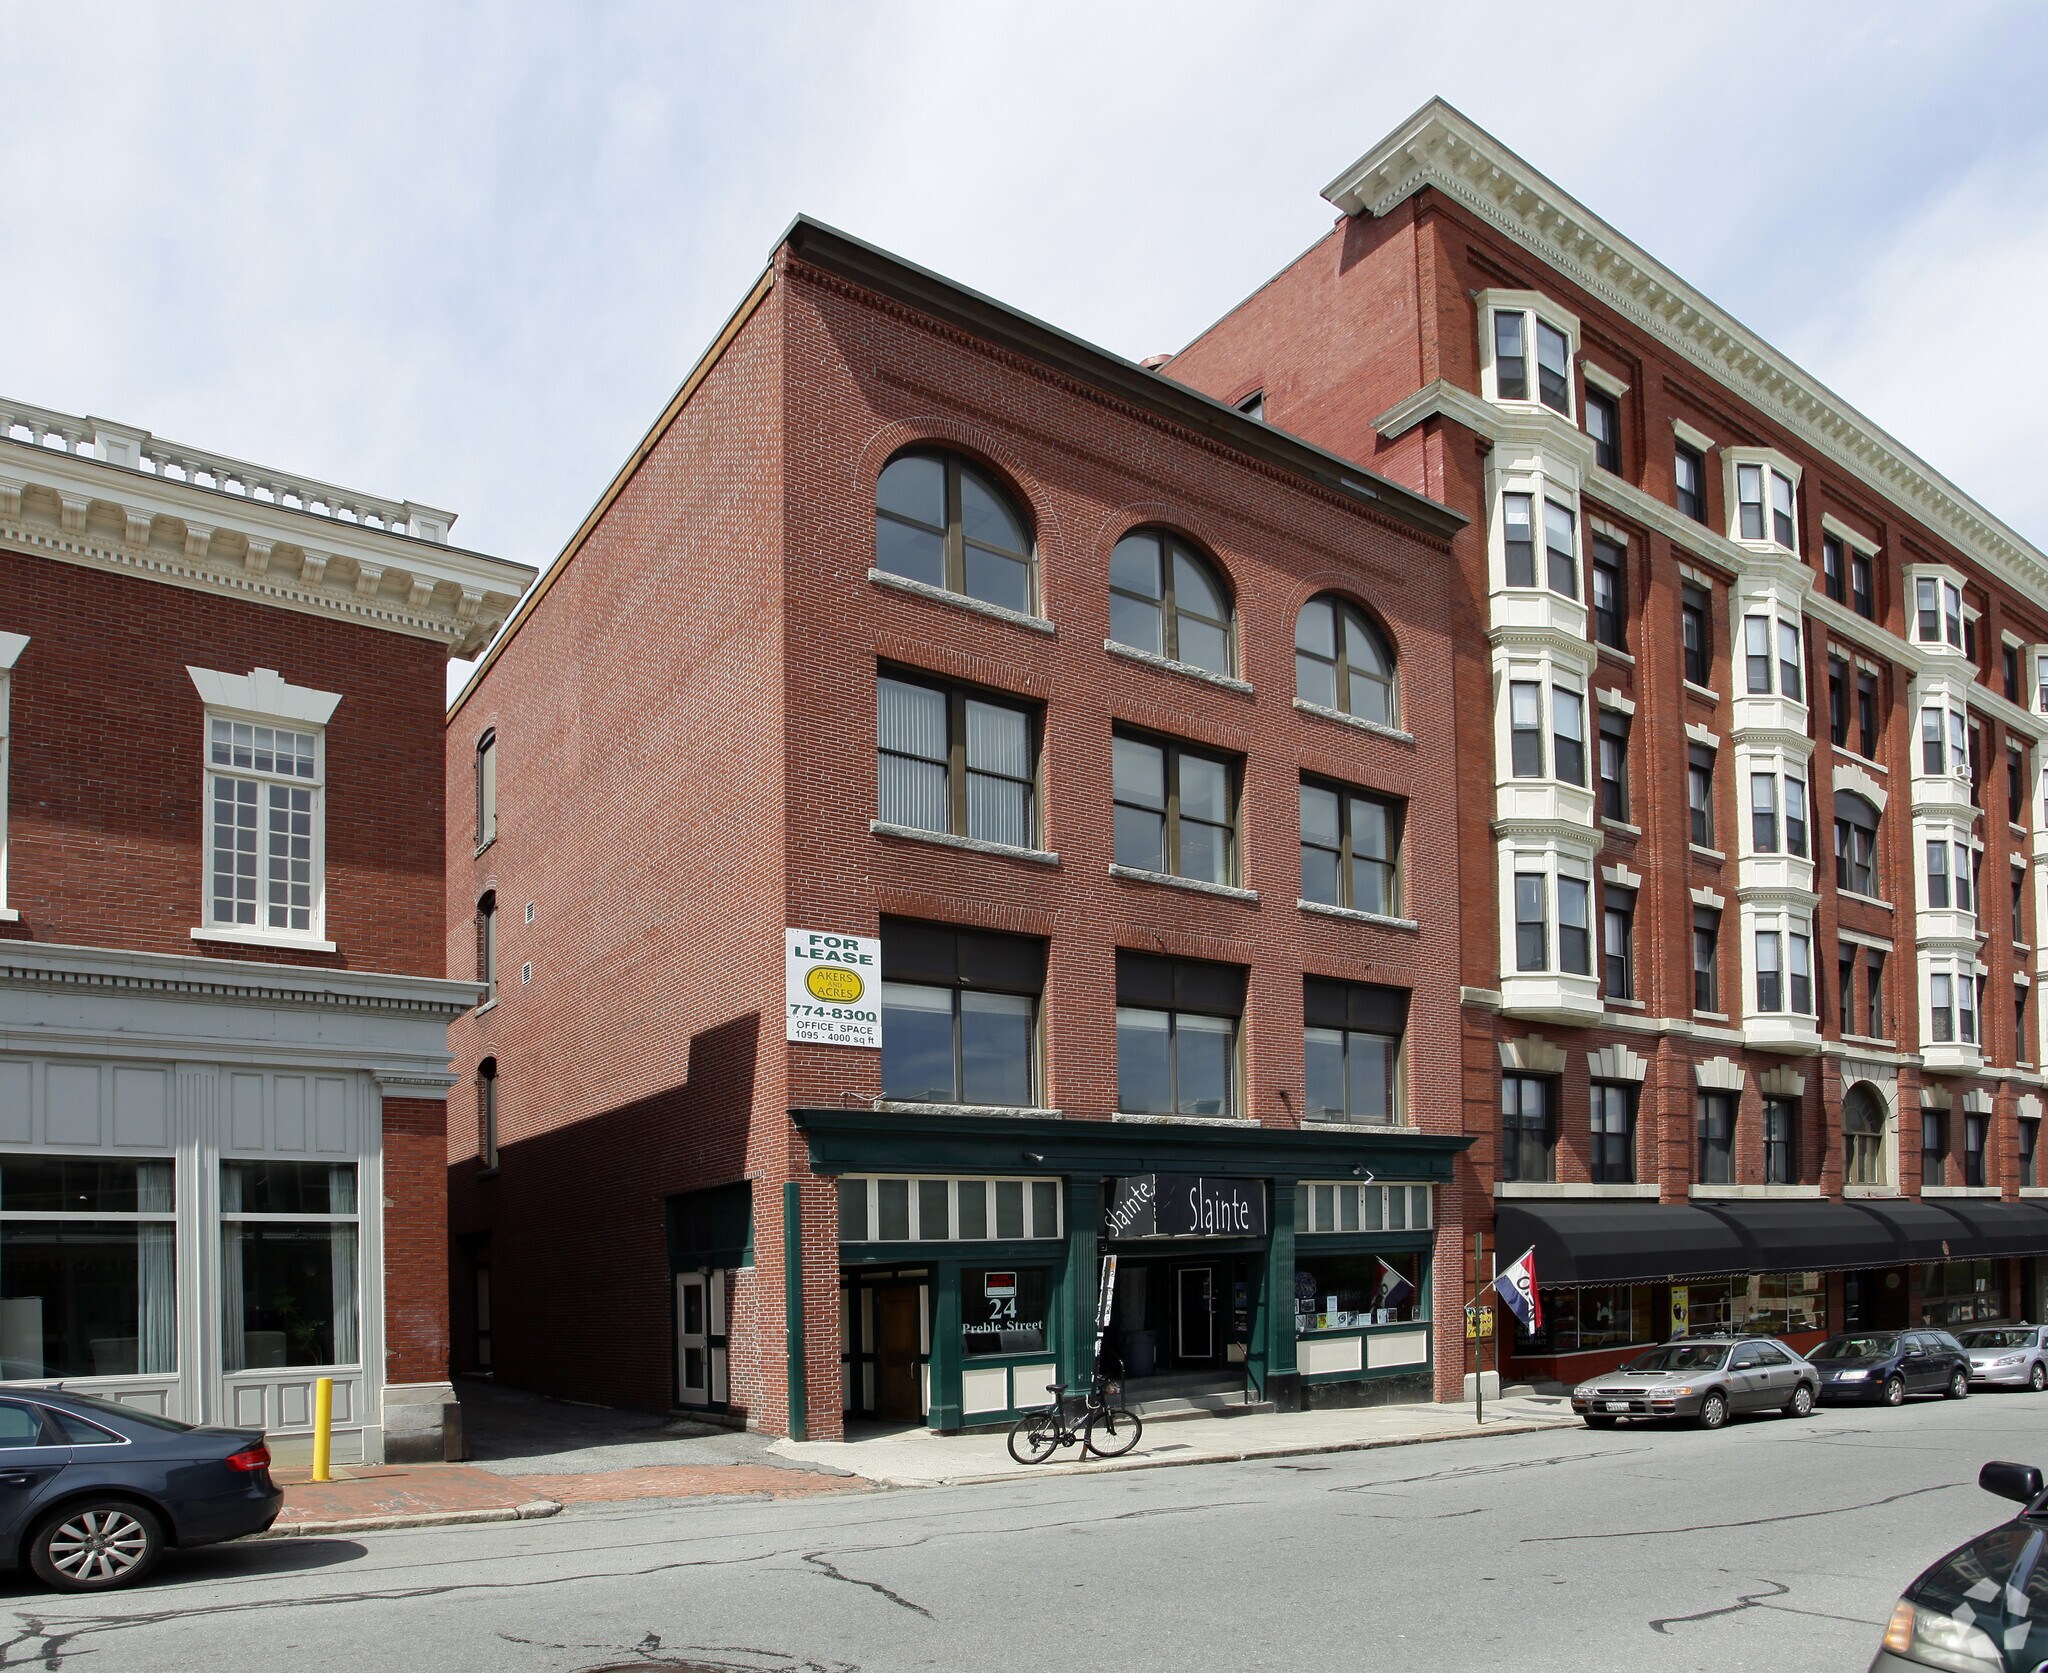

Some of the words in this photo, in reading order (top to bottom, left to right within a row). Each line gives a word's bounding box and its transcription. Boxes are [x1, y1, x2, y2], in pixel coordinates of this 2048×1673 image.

[809, 934, 859, 951] FOR
[794, 946, 874, 966] LEASE
[816, 970, 853, 983] AKERS
[817, 987, 853, 999] ACRES
[789, 1003, 877, 1023] 774-8300
[796, 1020, 834, 1032] OFFICE
[840, 1025, 873, 1035] SPACE
[795, 1030, 819, 1040] 1095
[828, 1034, 851, 1043] 4000
[853, 1036, 865, 1045] sq
[867, 1036, 875, 1045] ft
[1104, 1182, 1154, 1238] Slainte
[1189, 1177, 1249, 1235] Slainte
[989, 1297, 1017, 1320] 24
[962, 1321, 1002, 1335] Preble
[1006, 1319, 1043, 1332] Street
